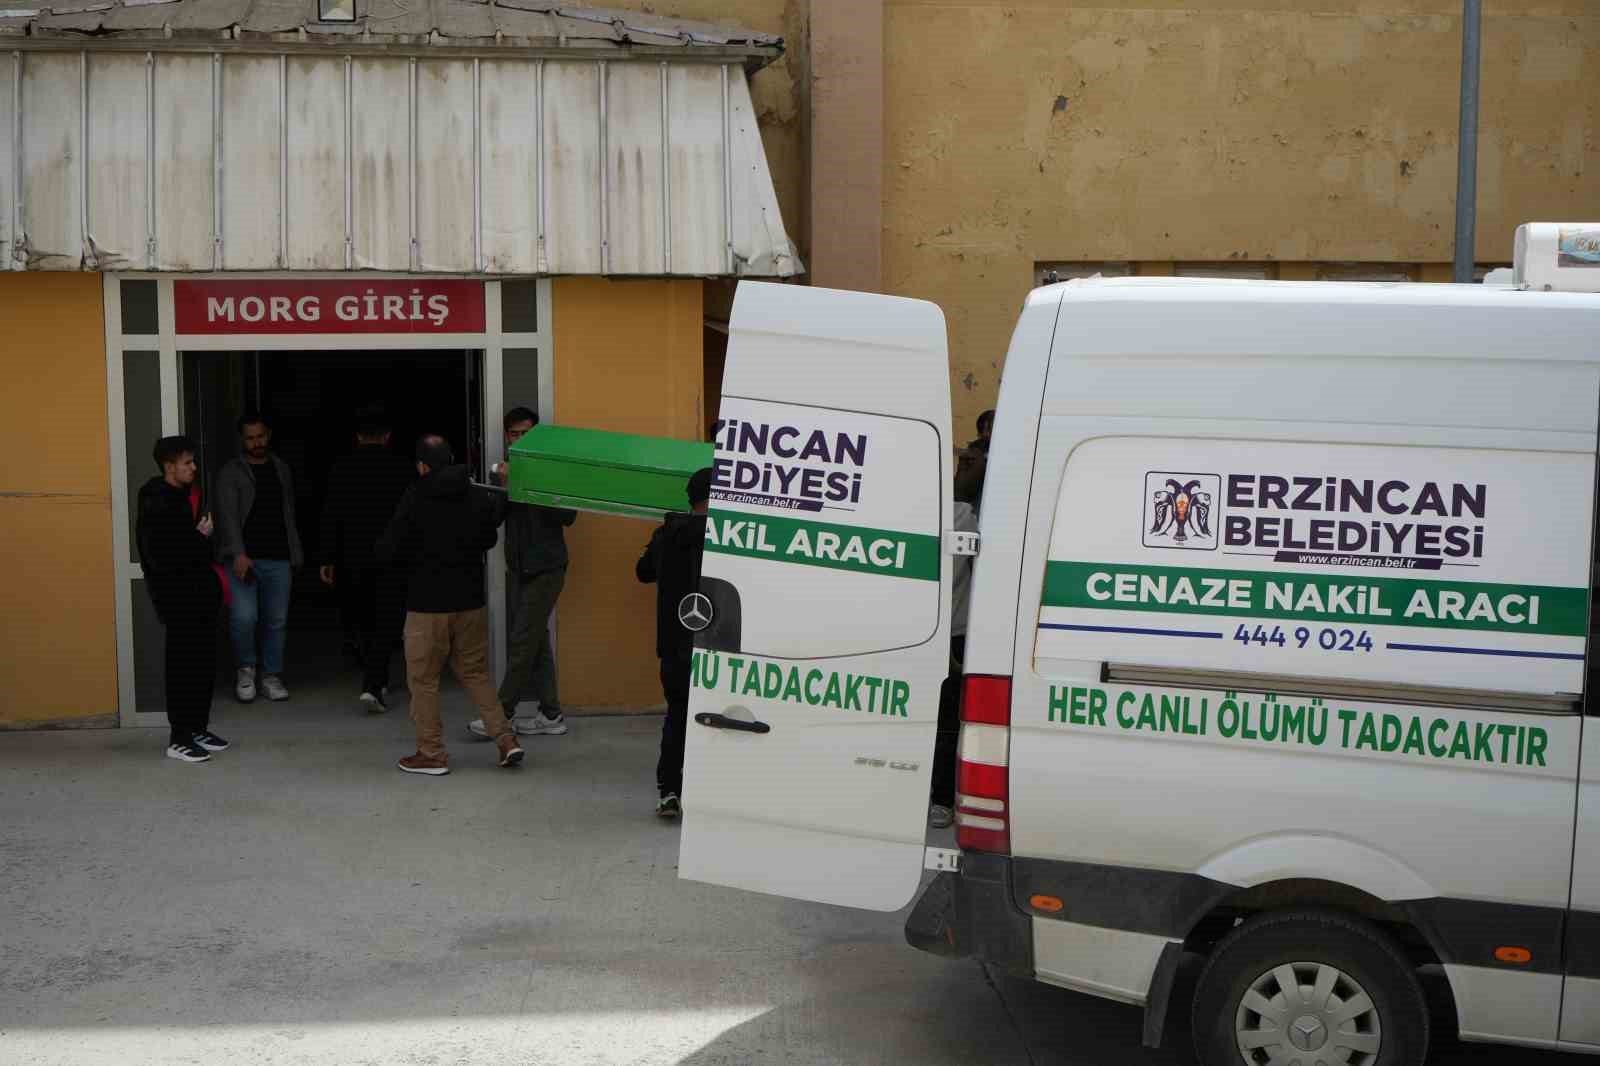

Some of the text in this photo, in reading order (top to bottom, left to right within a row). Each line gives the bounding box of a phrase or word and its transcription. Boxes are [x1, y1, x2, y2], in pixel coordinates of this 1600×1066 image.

[207, 288, 449, 326] MORG GİRİŞ
[785, 528, 907, 569] ARACI
[1298, 552, 1417, 570] www.erzincan.bel.tr
[1086, 572, 1252, 609] CENAZE
[1403, 588, 1540, 625] ARACI
[1233, 623, 1374, 652] 444 9 024
[727, 656, 911, 718] TADACAKTIR
[1047, 685, 1548, 767] HER CANLI ÖLÜMÜ TADACAKTIR
